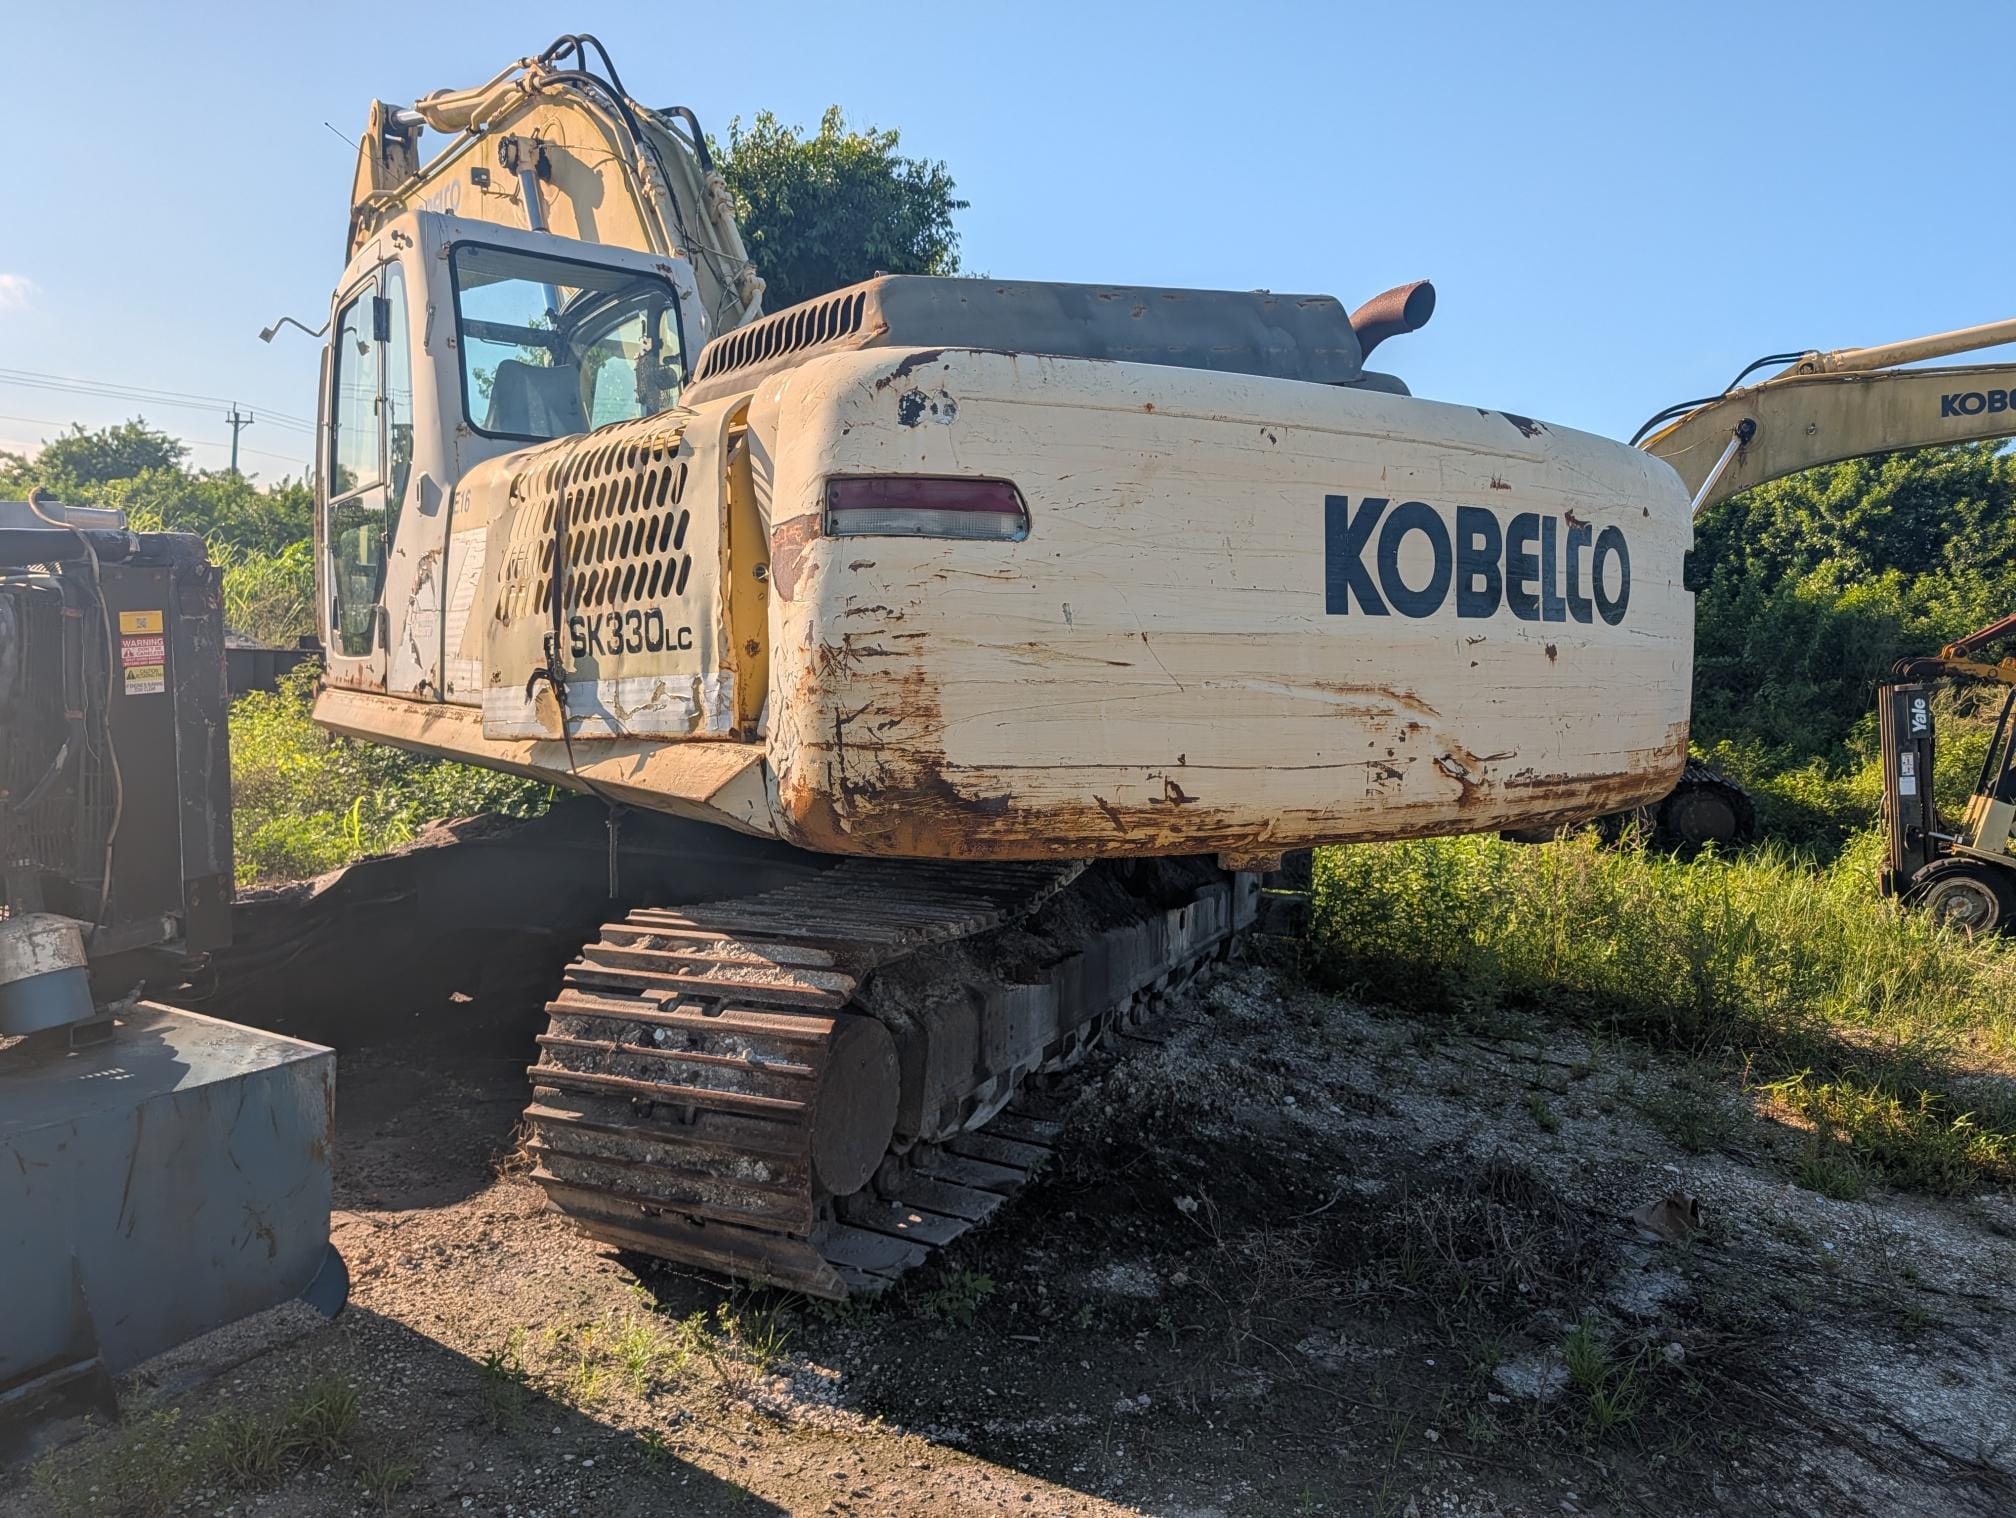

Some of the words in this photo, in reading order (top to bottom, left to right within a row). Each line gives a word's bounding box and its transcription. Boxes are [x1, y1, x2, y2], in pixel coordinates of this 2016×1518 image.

[1325, 494, 1631, 626] KOBELCO
[122, 638, 164, 648] WARNING
[570, 607, 692, 658] SK330LC
[1912, 698, 1927, 732] Yale
